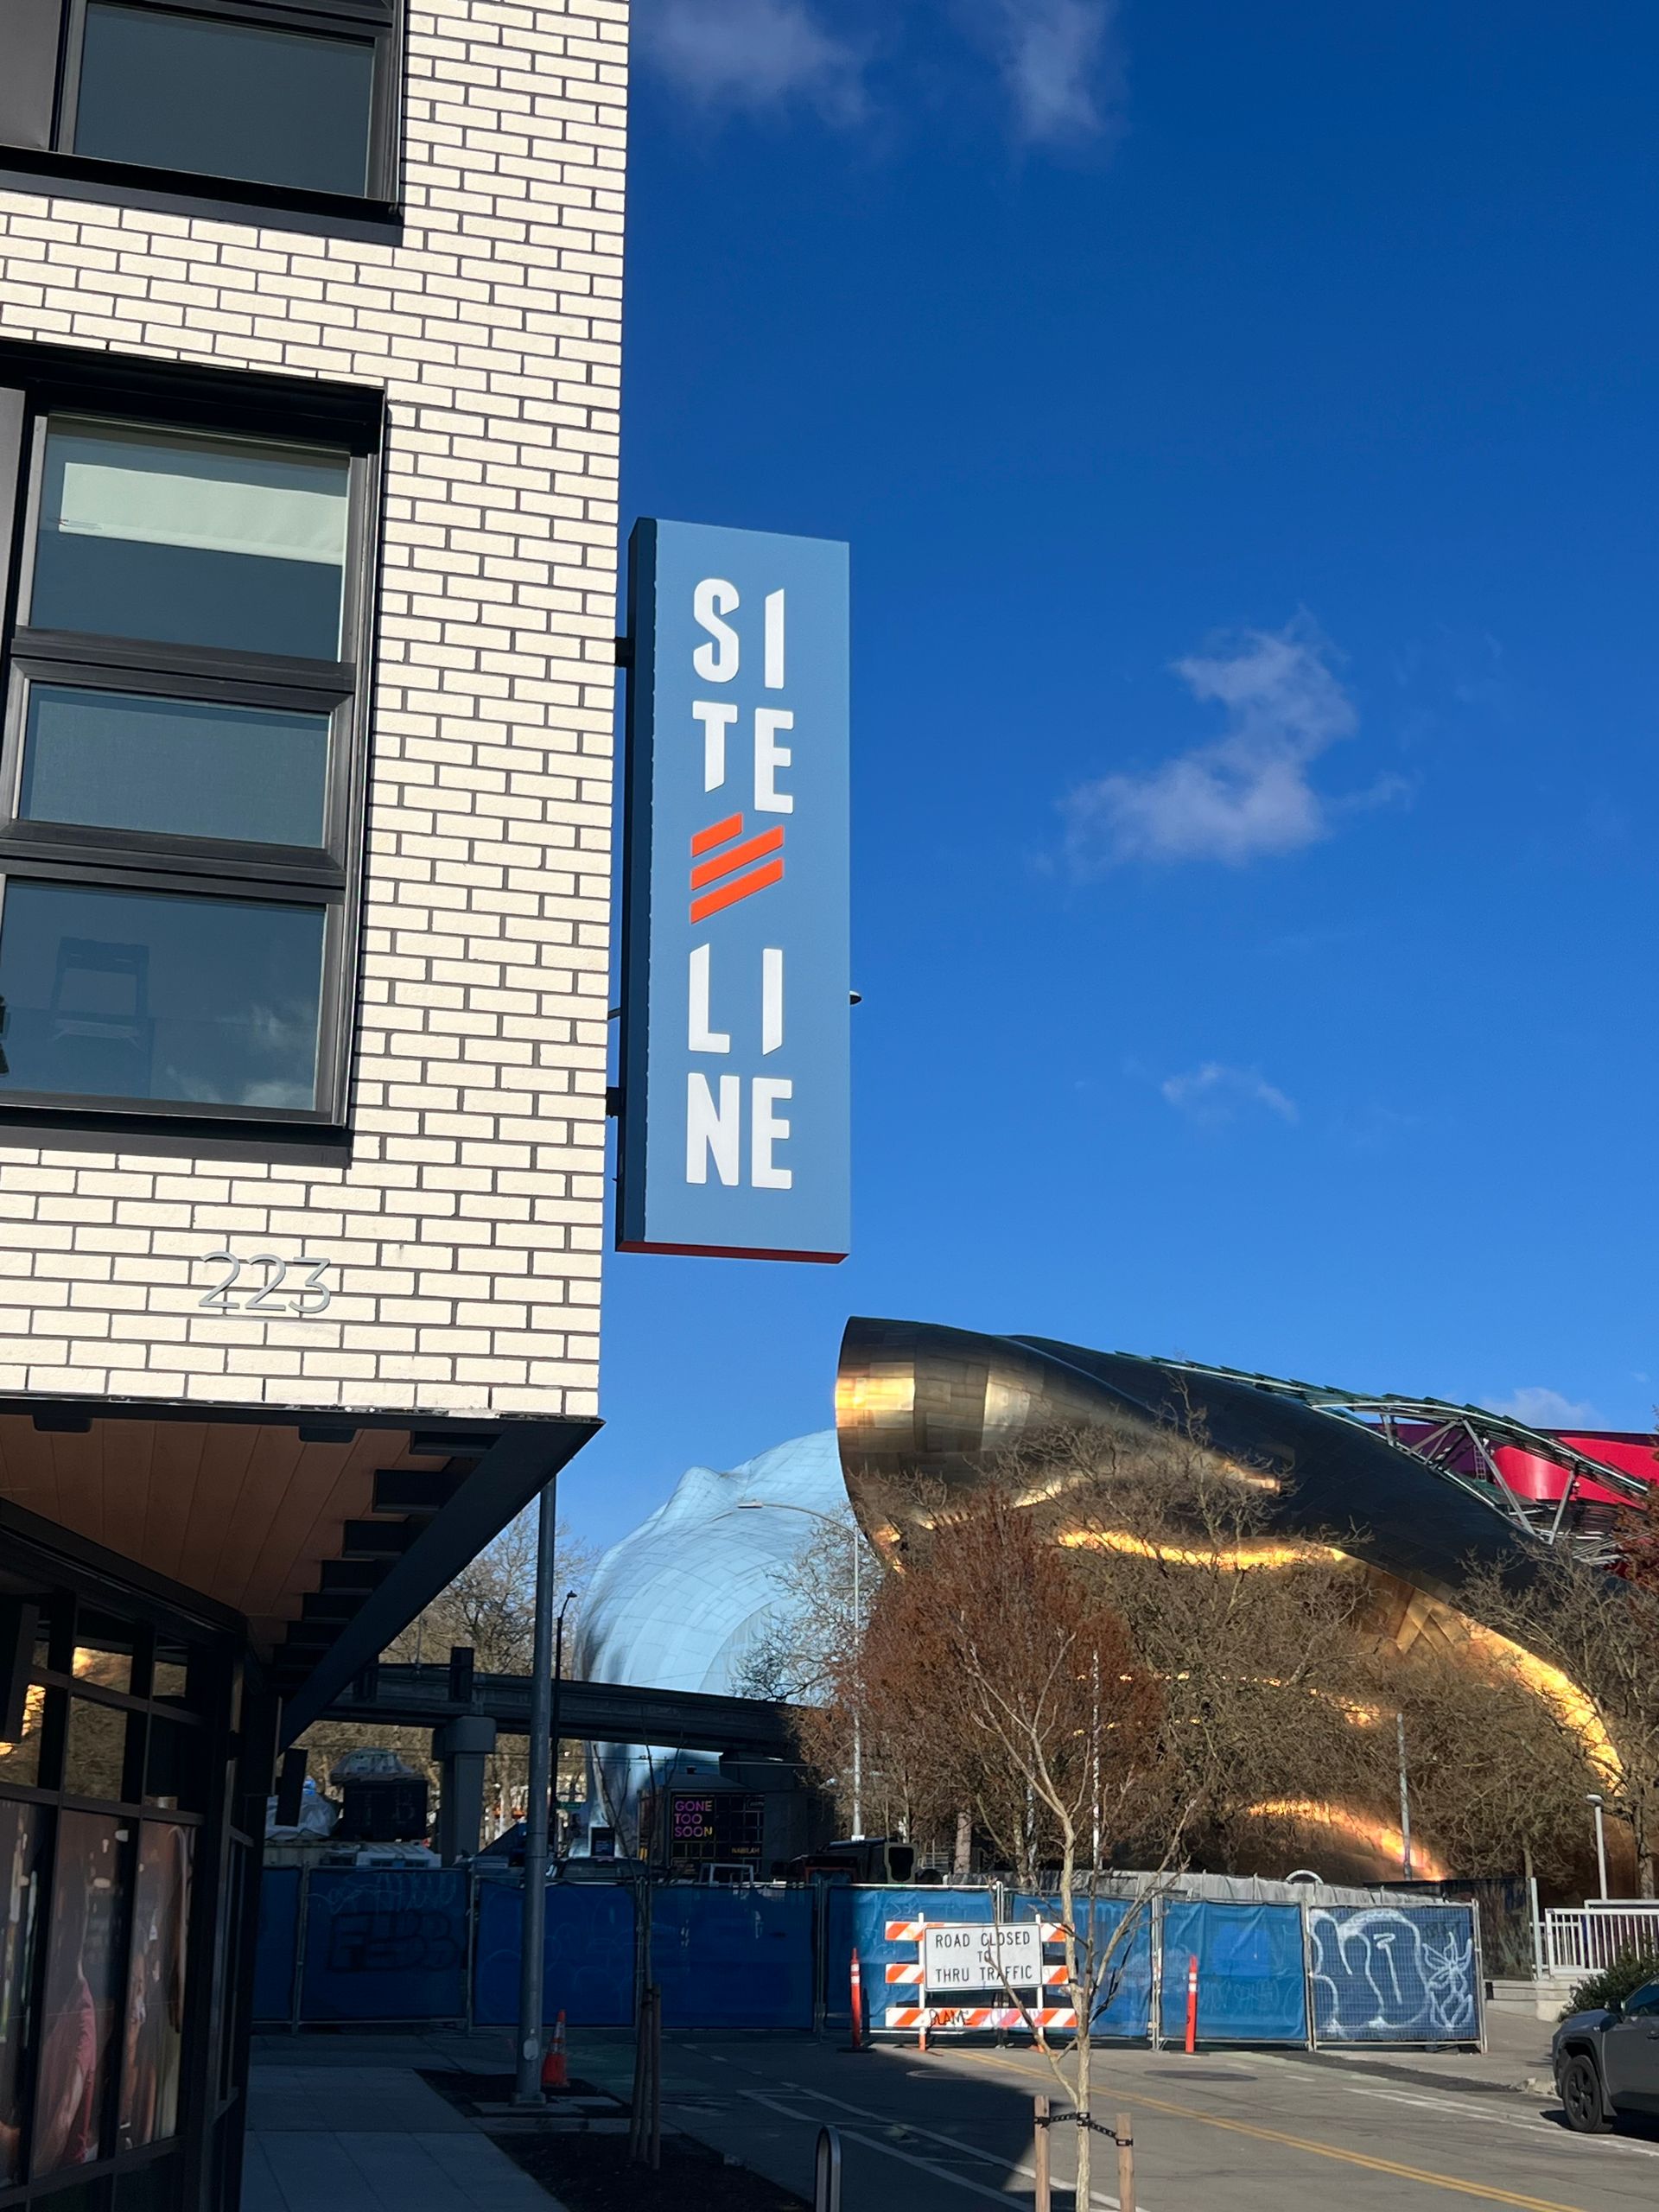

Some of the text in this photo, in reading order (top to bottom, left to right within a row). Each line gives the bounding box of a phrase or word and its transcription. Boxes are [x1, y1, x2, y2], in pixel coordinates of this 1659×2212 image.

[199, 1250, 331, 1314] 223
[675, 1800, 713, 1812] GONE
[674, 1813, 702, 1825] TOO
[674, 1826, 713, 1838] SOON
[935, 1930, 1031, 1948] ROAD CLOSED
[977, 1950, 991, 1963] TO
[935, 1967, 969, 1983] THRU
